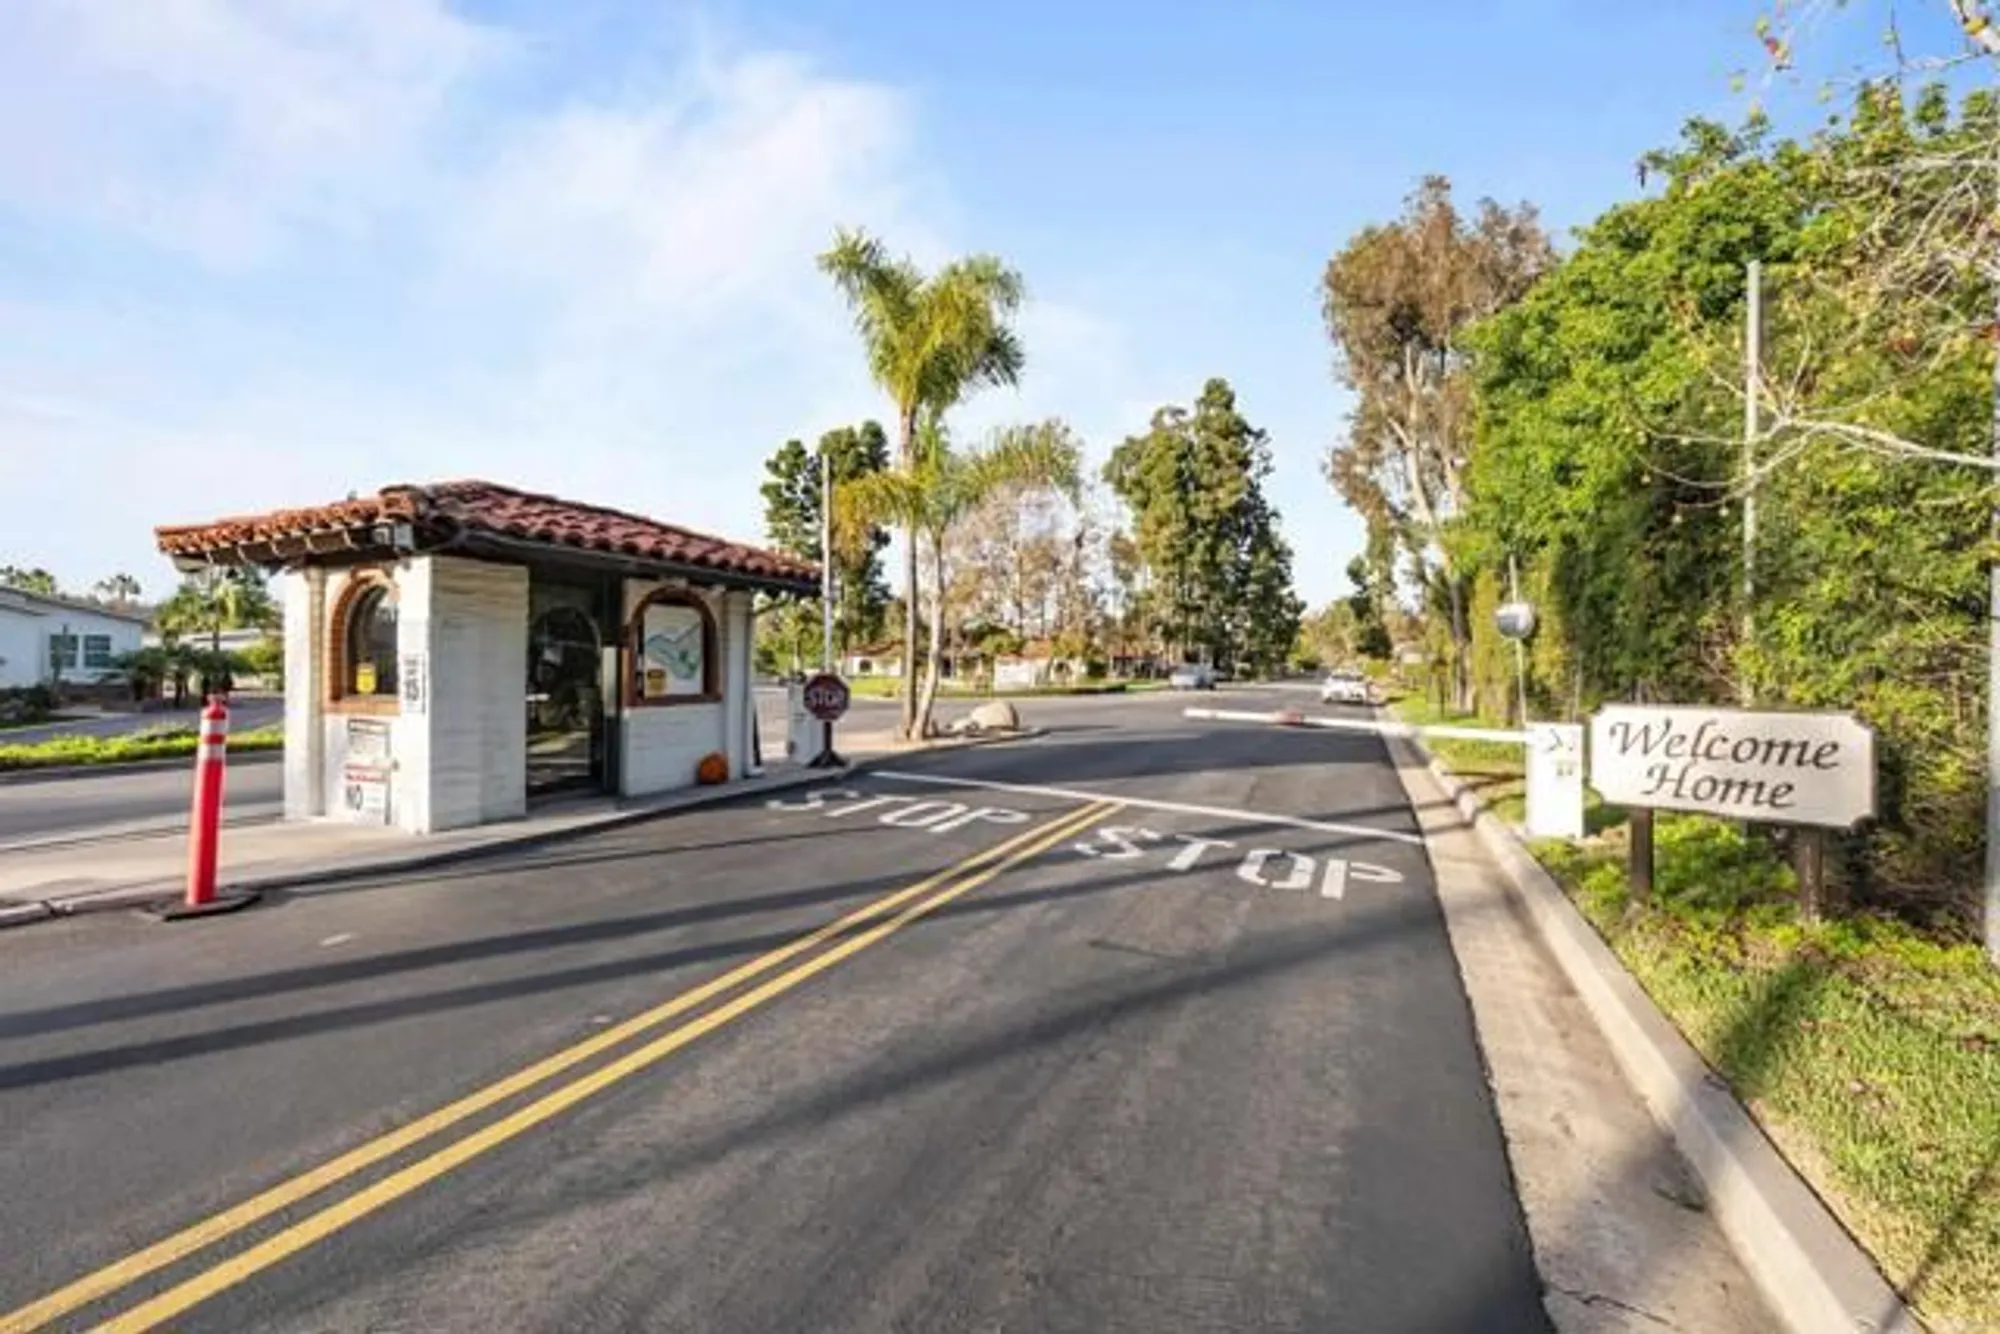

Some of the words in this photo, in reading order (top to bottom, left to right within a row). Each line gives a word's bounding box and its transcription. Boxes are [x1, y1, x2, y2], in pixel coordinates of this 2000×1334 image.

[804, 687, 845, 707] STOP
[1609, 717, 1840, 770] Welcome
[1641, 763, 1796, 808] Home
[766, 788, 1031, 833] STOP
[1075, 828, 1405, 900] STOP
